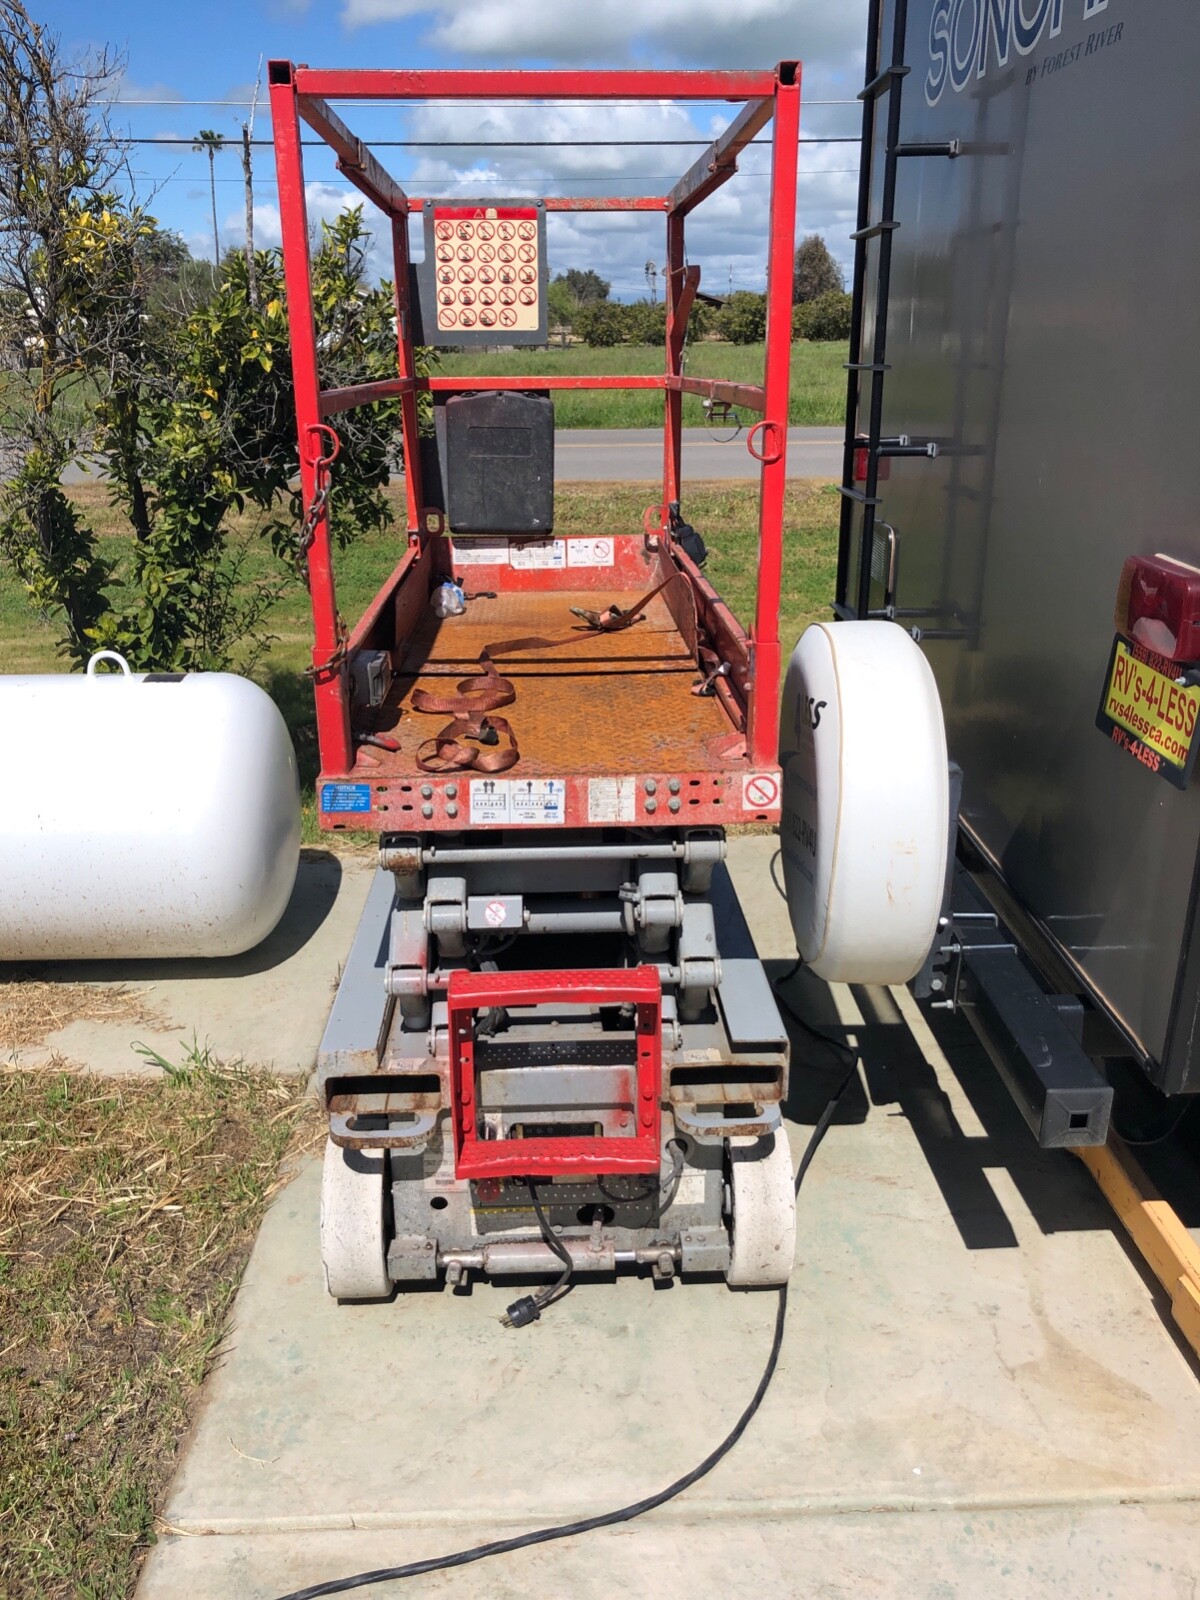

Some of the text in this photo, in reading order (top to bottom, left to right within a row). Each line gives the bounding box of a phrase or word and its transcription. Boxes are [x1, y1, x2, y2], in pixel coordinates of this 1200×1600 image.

[925, 0, 1108, 107] SONO
[1025, 22, 1124, 86] BY FOREST RIVER
[1113, 654, 1197, 738] RV's-4-LESS
[1109, 697, 1188, 760] rvs4lessca.com
[1112, 726, 1161, 772] RV's-4-LESS
